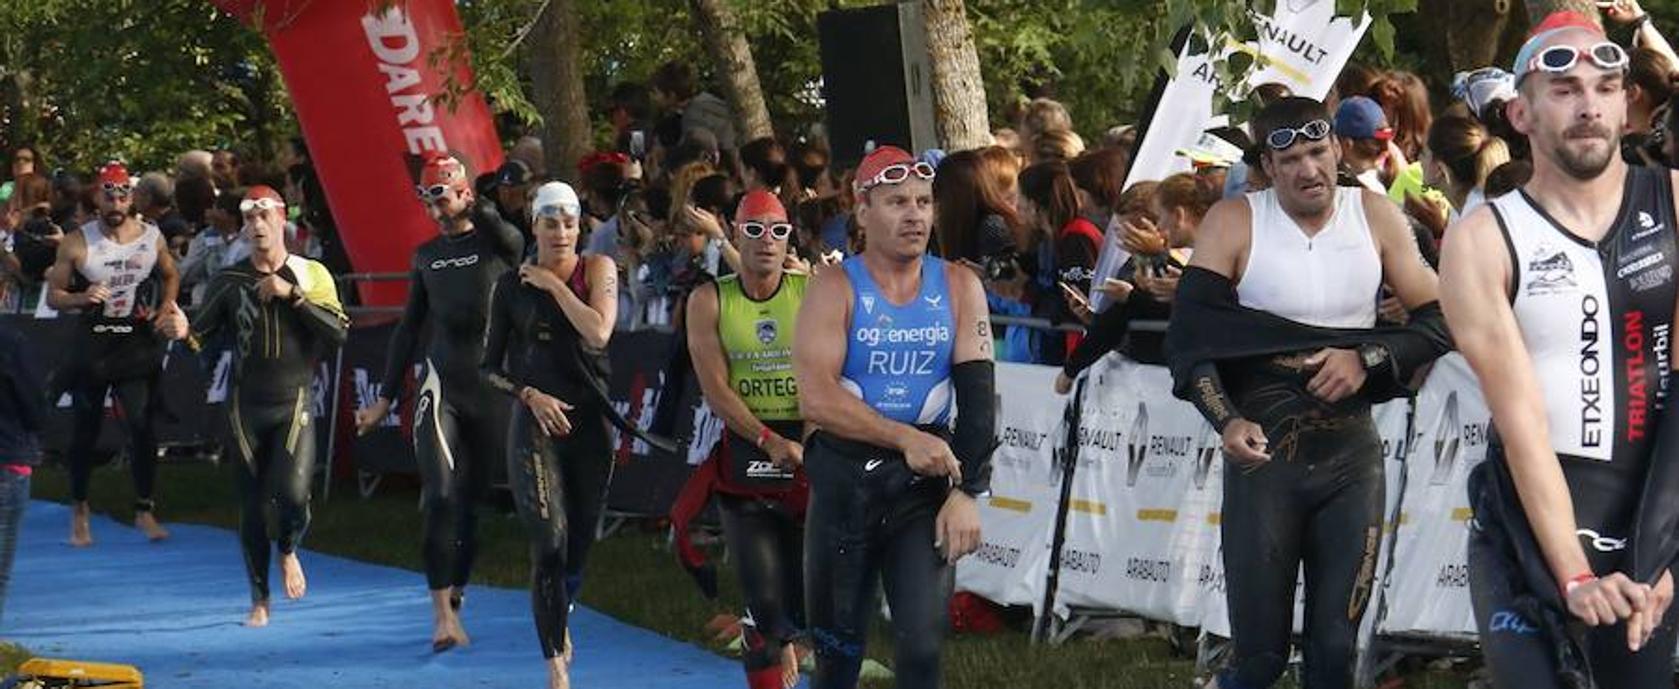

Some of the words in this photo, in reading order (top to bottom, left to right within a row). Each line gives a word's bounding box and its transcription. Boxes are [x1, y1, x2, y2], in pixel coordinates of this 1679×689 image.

[361, 4, 447, 155] DARE
[868, 350, 936, 375] RUIZ
[1580, 295, 1602, 448] ETXEONDO
[1624, 310, 1647, 443] TRIATLON
[1003, 426, 1048, 451] RENAULT
[1151, 435, 1192, 457] RENAULT
[1126, 557, 1170, 582] ARABAUTO
